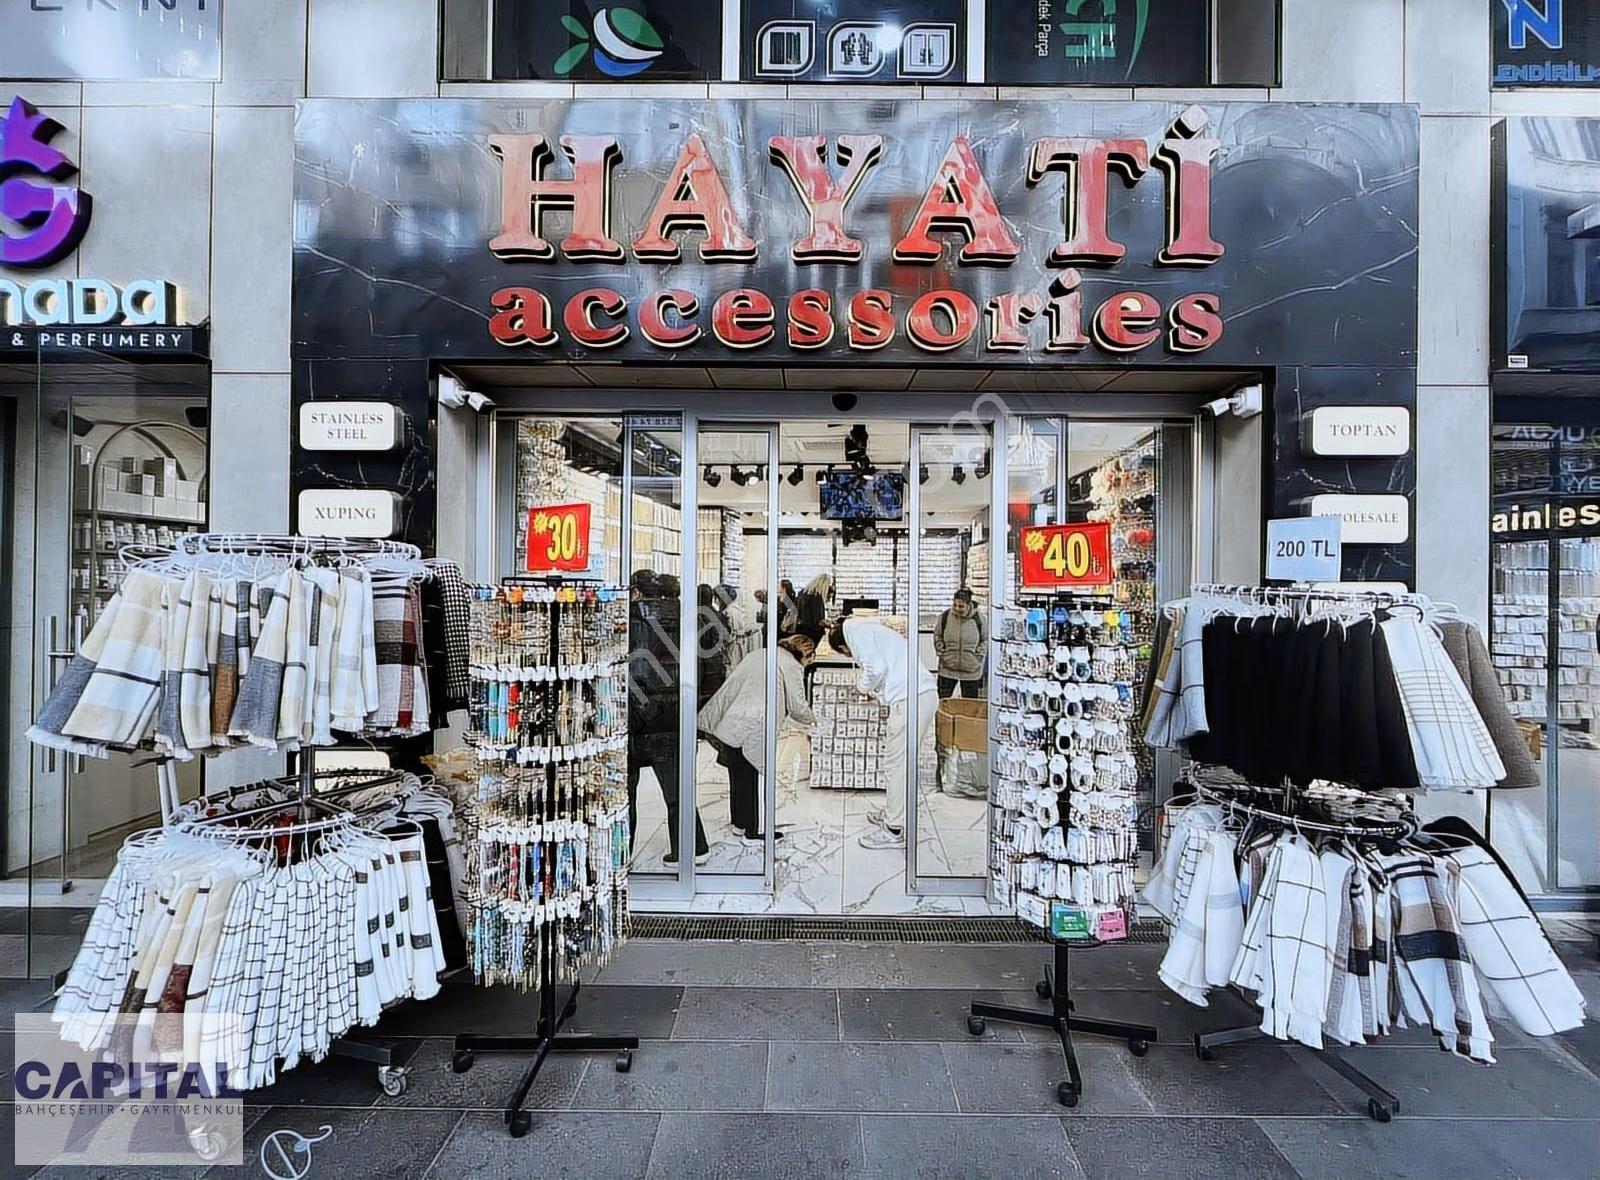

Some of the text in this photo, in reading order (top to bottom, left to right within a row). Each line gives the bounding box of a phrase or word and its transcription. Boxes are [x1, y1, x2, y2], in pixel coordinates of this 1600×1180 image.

[1035, 24, 1051, 57] Parça
[488, 104, 1226, 264] HAYATİ
[488, 268, 1224, 353] accessories
[40, 332, 182, 347] PERFUMERY
[311, 412, 385, 425] STAINLESS
[327, 428, 368, 440] STEEL
[1329, 424, 1397, 437] TOPTAN
[315, 507, 376, 520] XUPING
[1276, 539, 1336, 558] 200 TL
